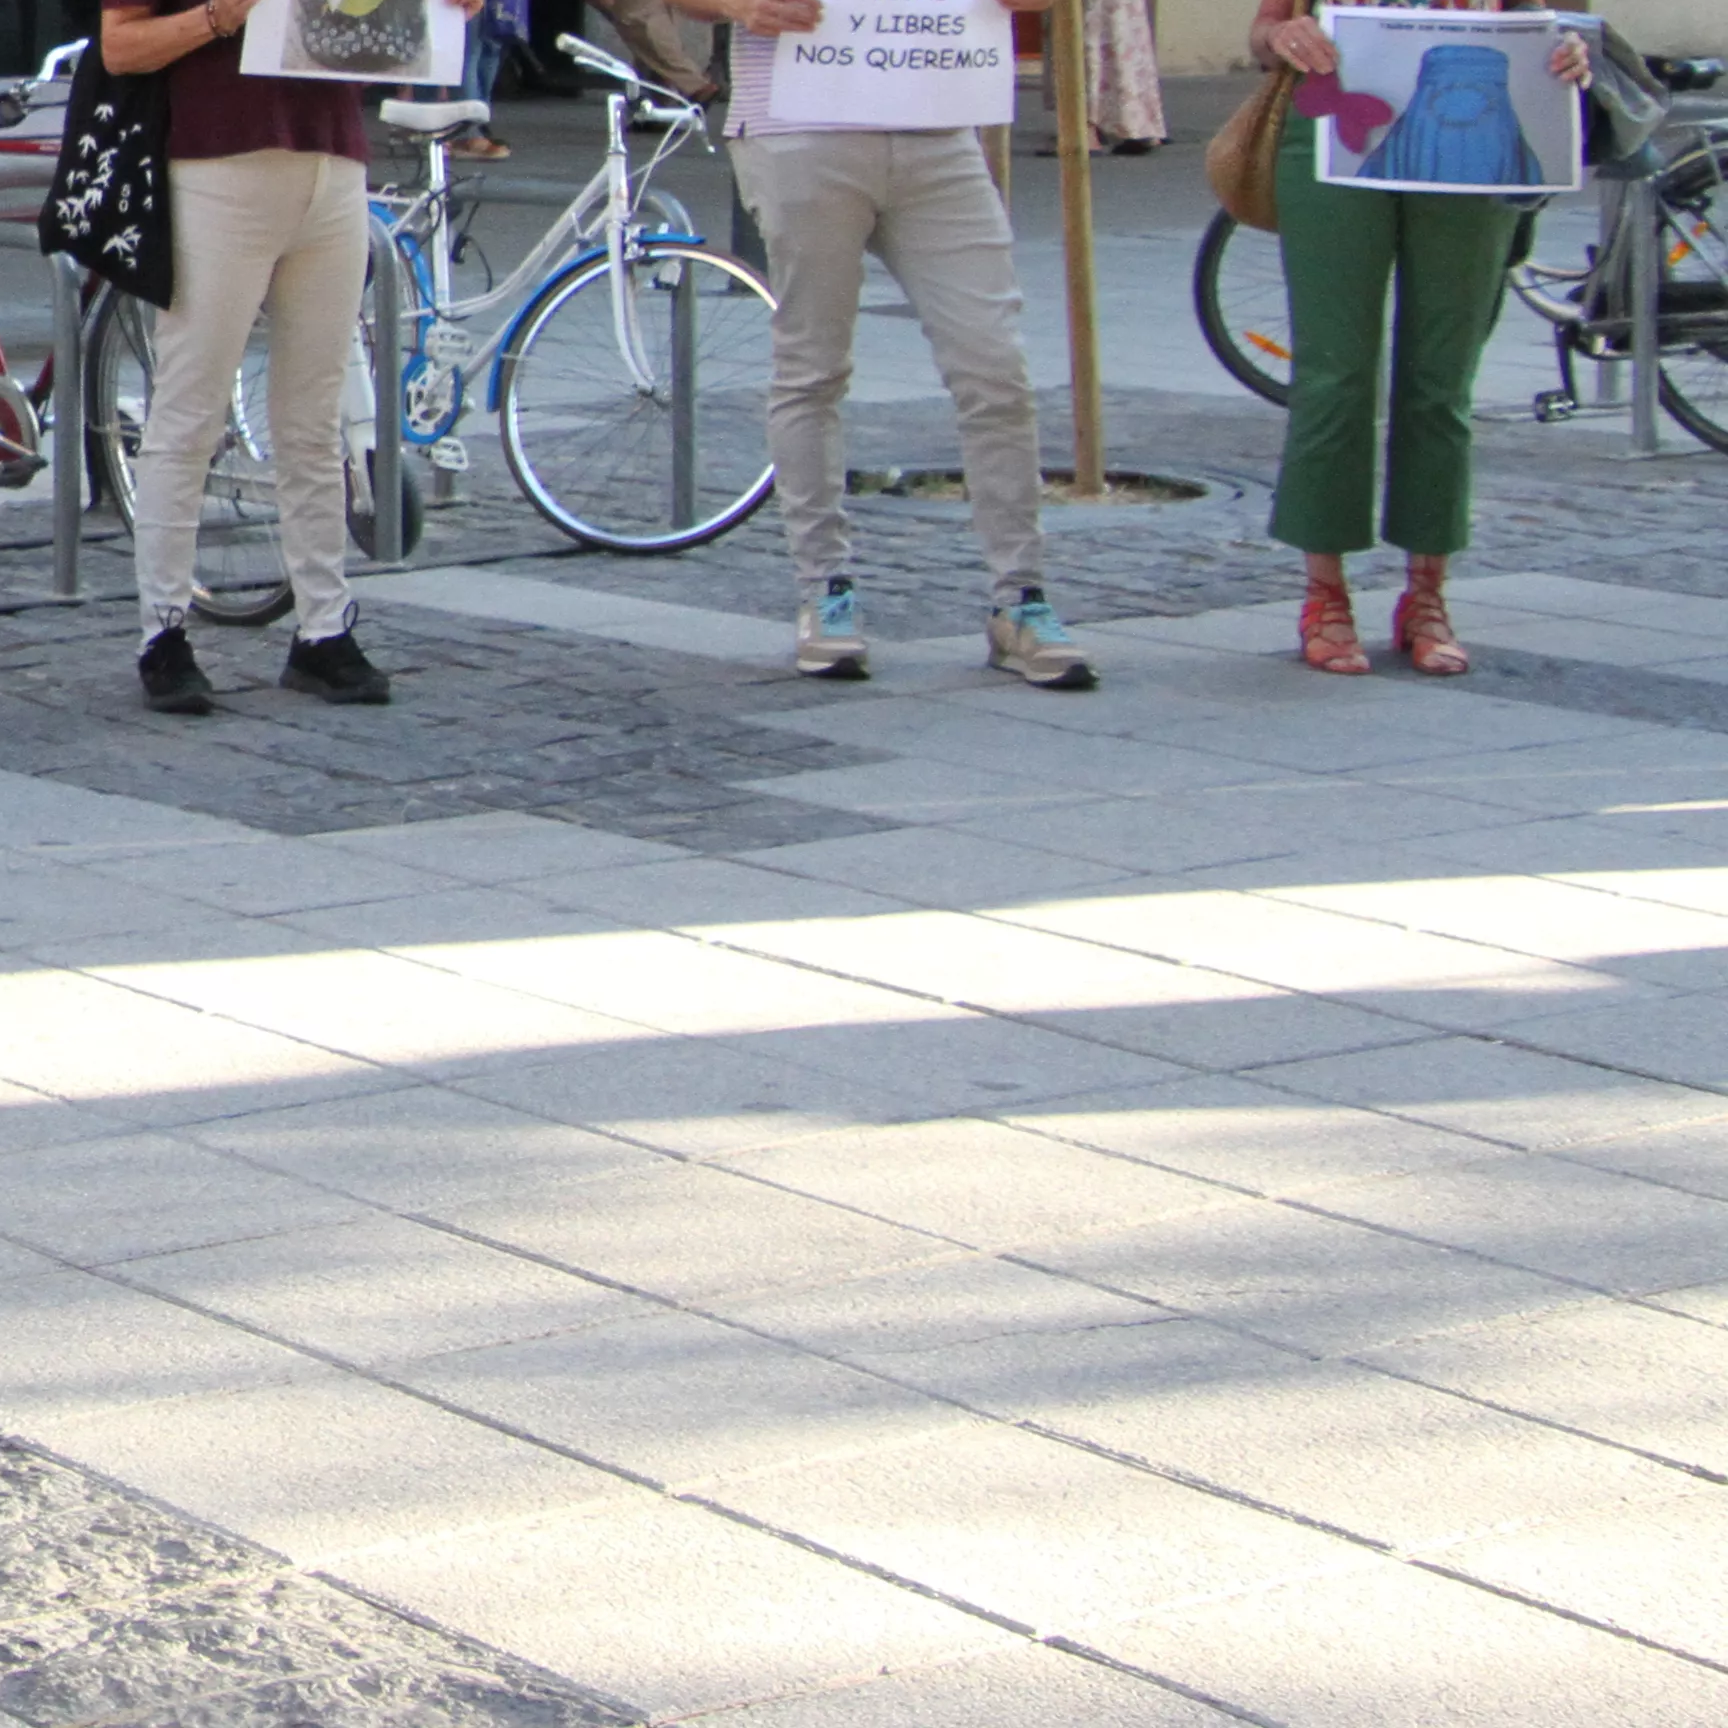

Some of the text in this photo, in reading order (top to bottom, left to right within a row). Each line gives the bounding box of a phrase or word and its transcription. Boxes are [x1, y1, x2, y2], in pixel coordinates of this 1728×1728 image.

[849, 13, 966, 35] Y LIBRES
[795, 44, 1000, 72] NOS QUEREMOS
